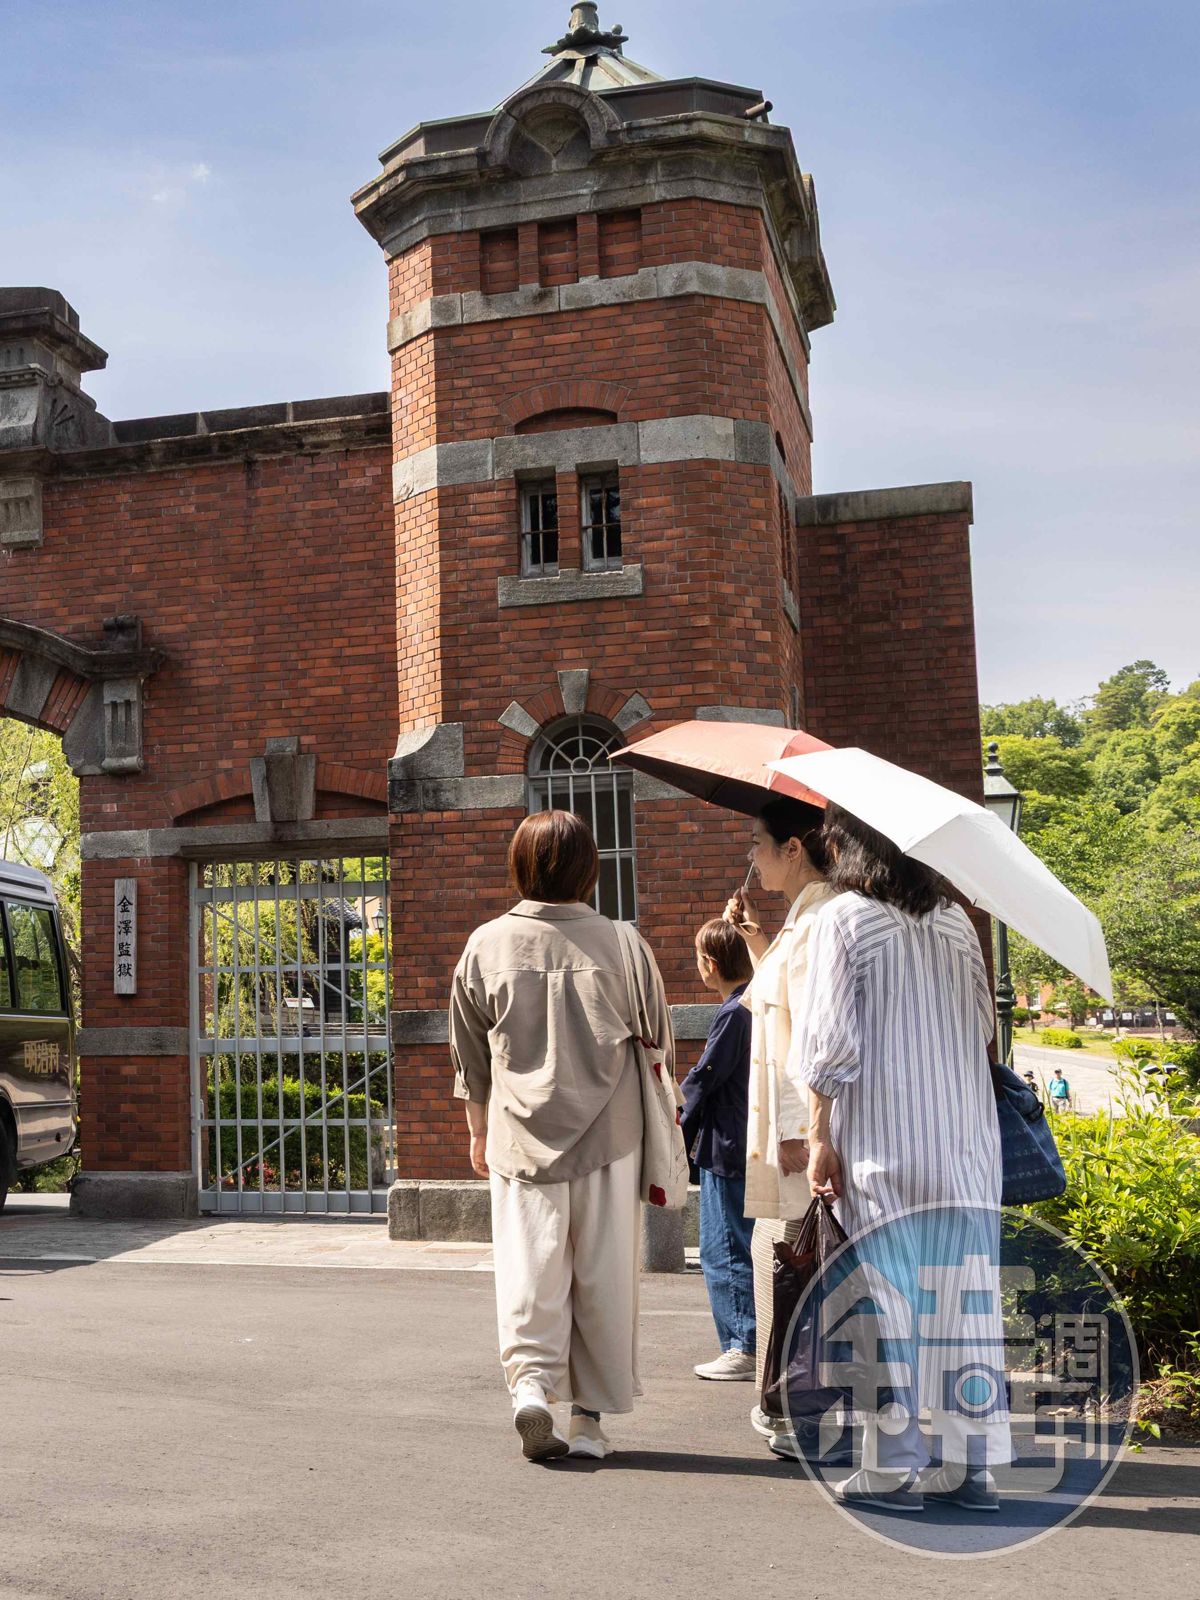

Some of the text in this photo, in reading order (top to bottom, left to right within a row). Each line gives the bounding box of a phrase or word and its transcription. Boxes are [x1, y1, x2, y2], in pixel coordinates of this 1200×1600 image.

[116, 895, 134, 978] 金澤監獄
[24, 1042, 60, 1074] 明治村
